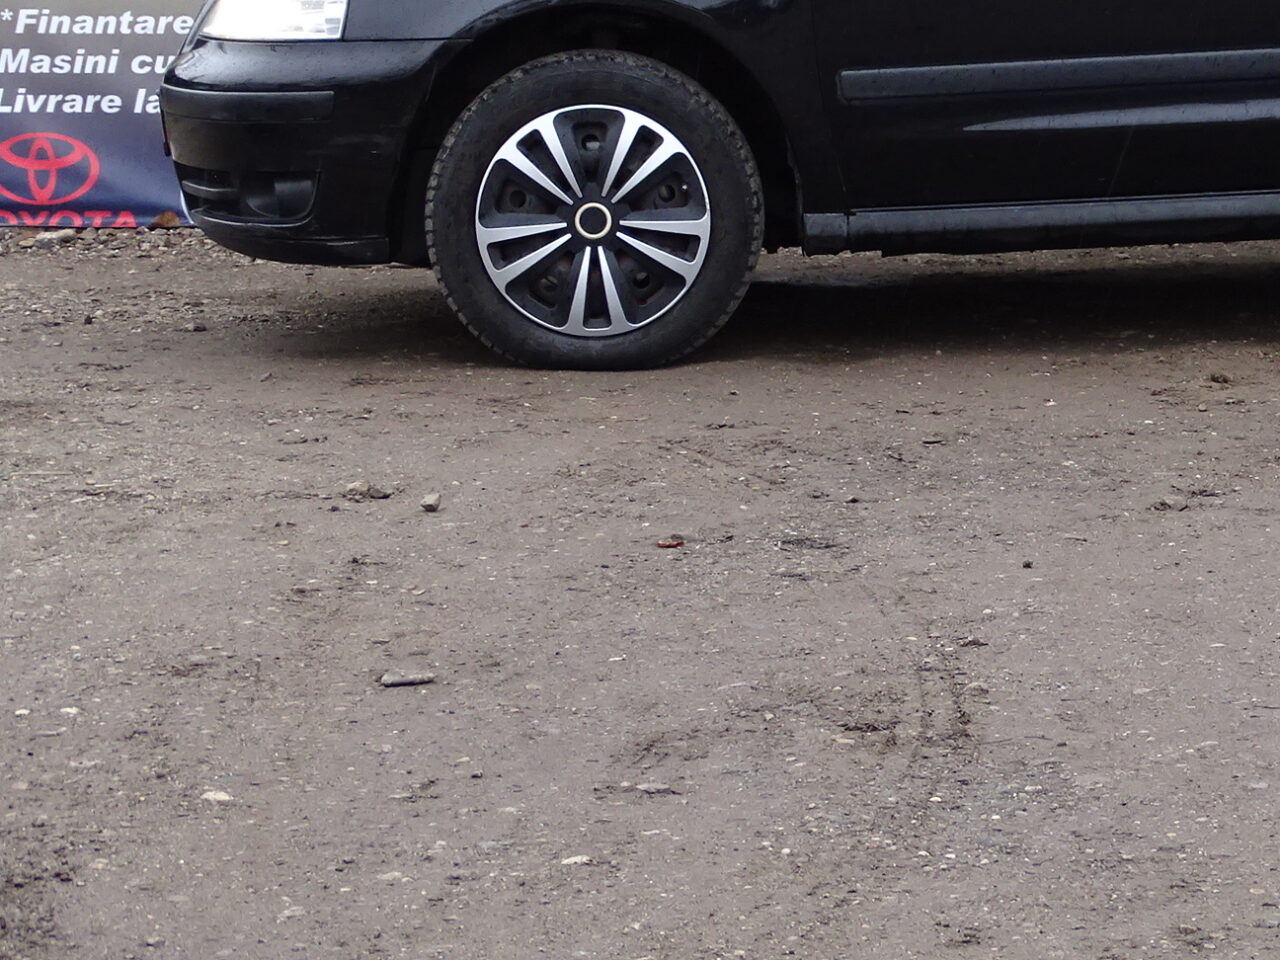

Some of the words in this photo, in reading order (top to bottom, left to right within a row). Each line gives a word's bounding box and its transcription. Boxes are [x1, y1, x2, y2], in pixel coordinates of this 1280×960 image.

[0, 48, 120, 74] Masini
[131, 54, 176, 74] cu
[0, 88, 122, 114] Livrare
